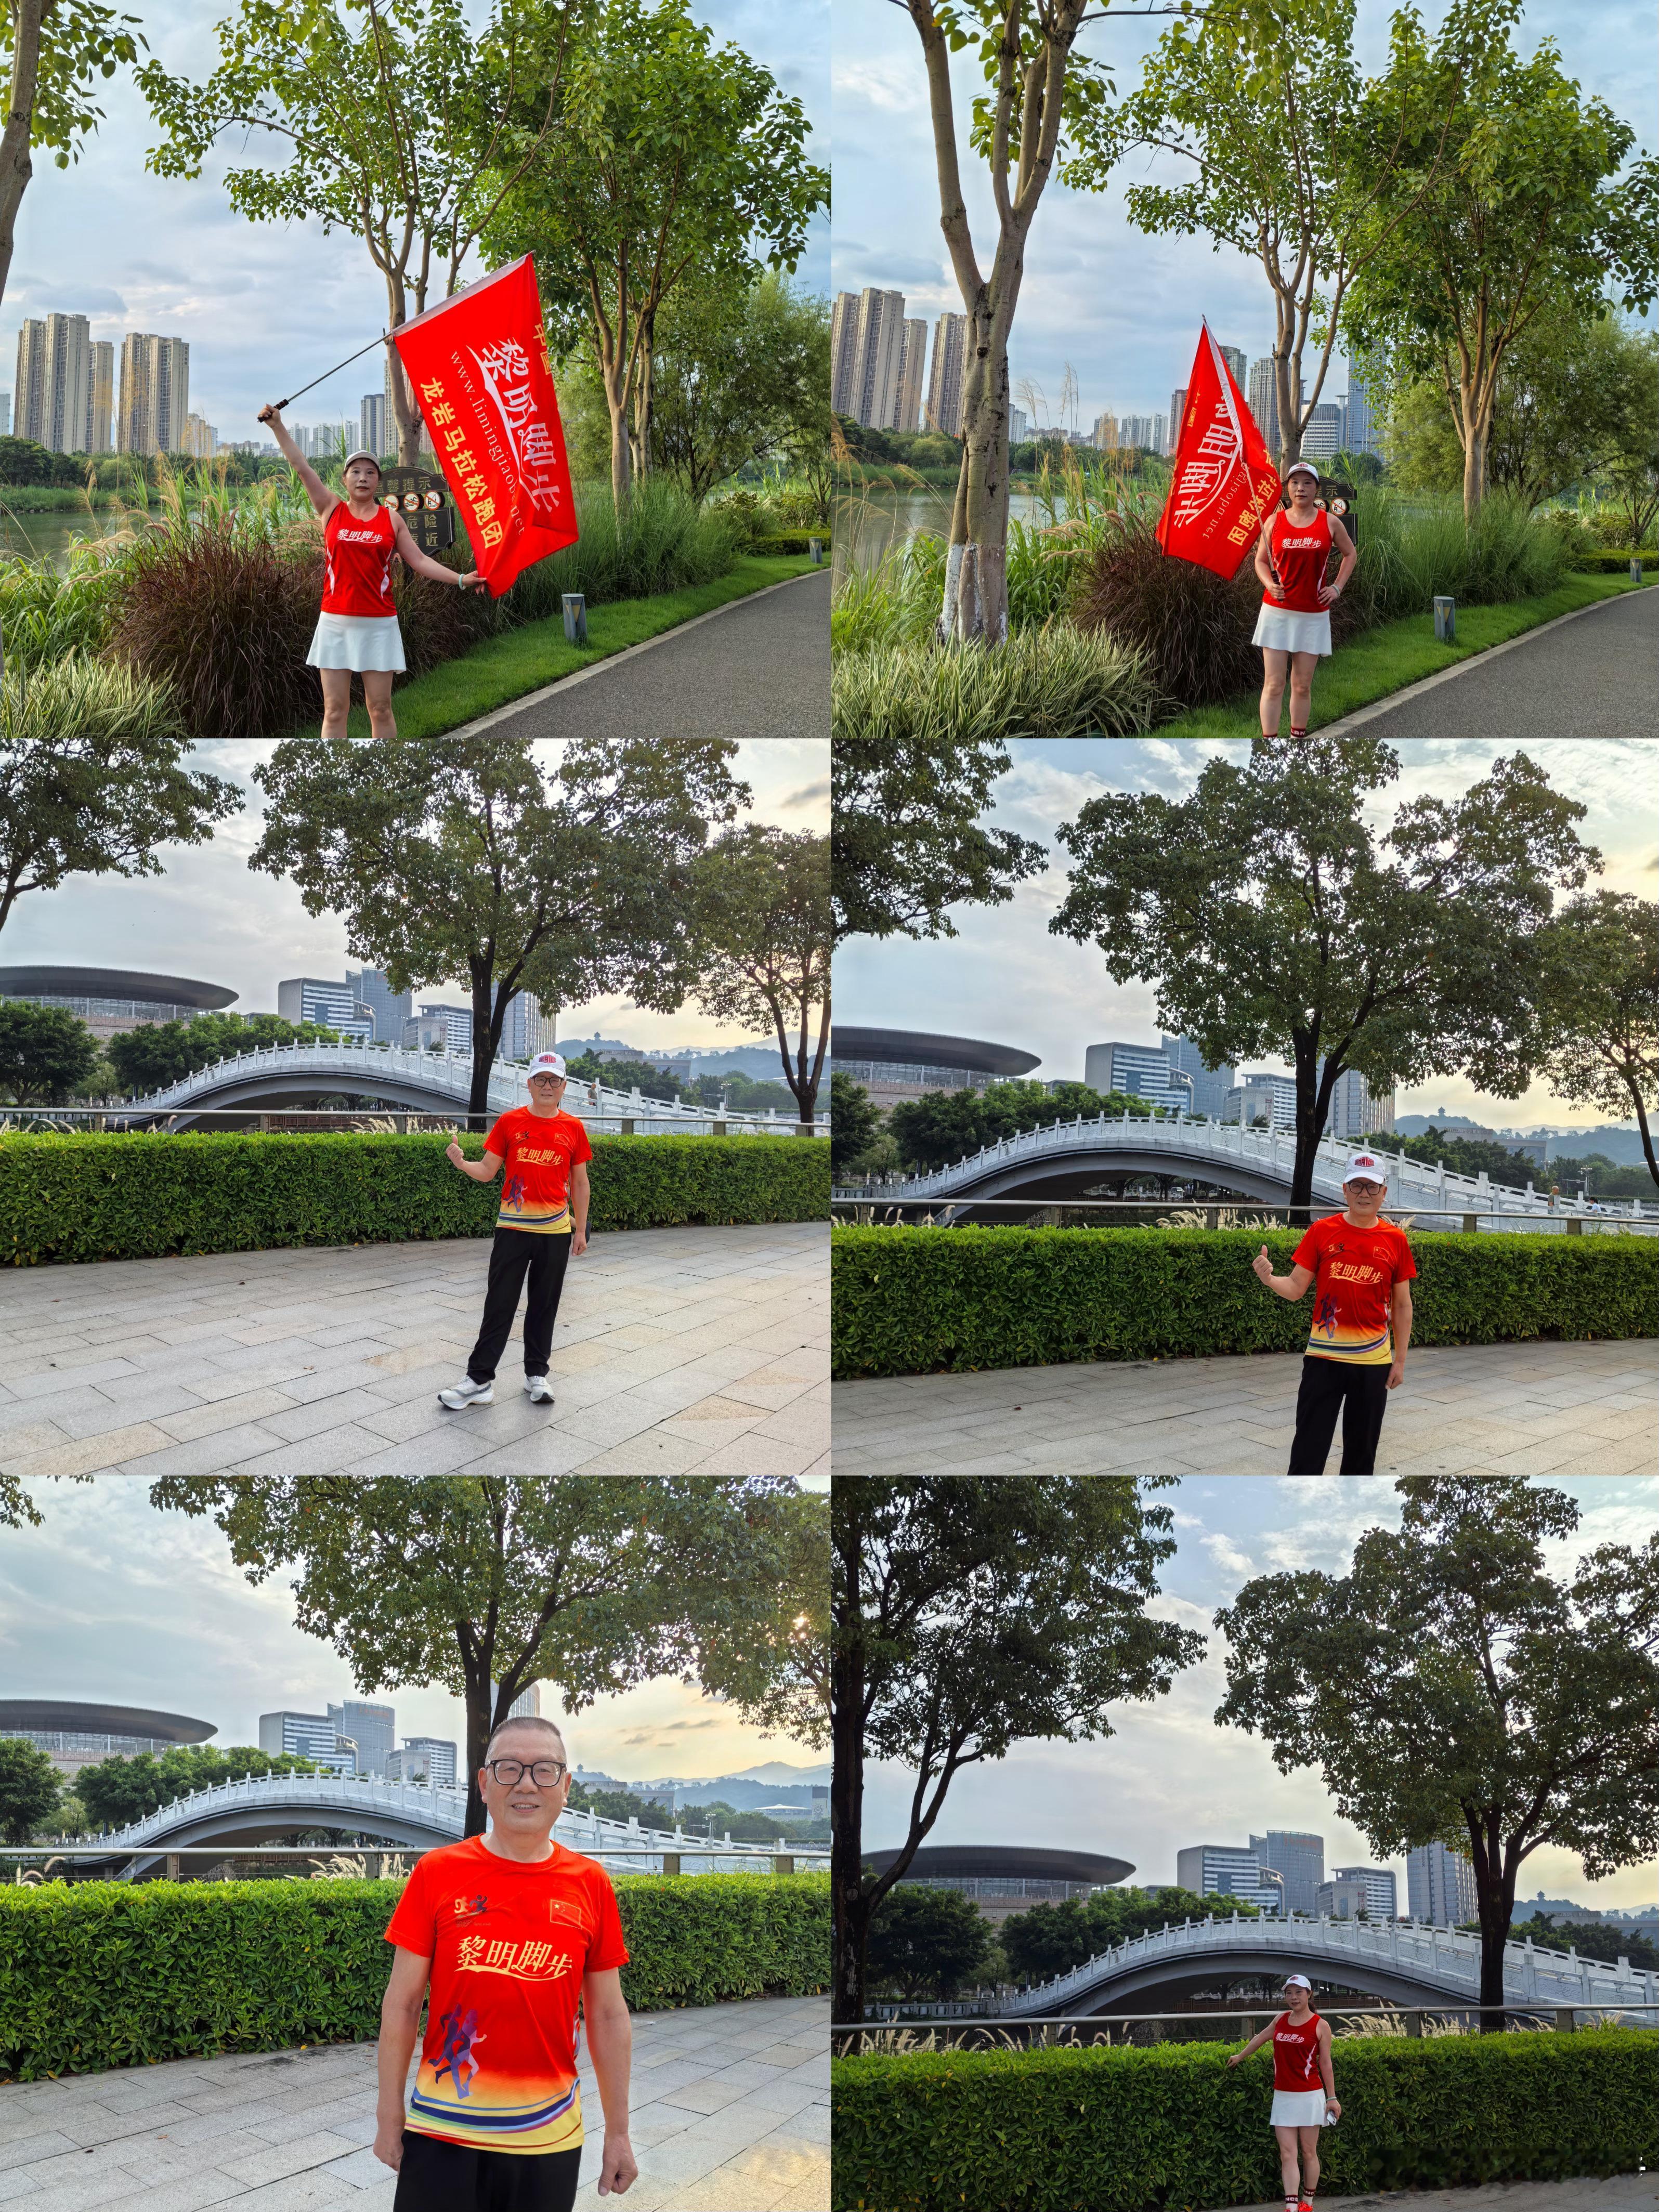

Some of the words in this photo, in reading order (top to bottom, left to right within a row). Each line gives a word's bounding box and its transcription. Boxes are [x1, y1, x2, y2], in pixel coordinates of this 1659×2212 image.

[466, 336, 560, 513] 黎明脚步
[420, 377, 503, 548] 龙岩马拉松跑团
[406, 514, 437, 529] 危险
[337, 529, 383, 543] 黎明脚步
[1282, 537, 1322, 548] 黎明脚步
[516, 1147, 563, 1166] 黎明脚步
[1328, 1262, 1383, 1284] 黎明脚步
[454, 1935, 572, 1981] 黎明脚步
